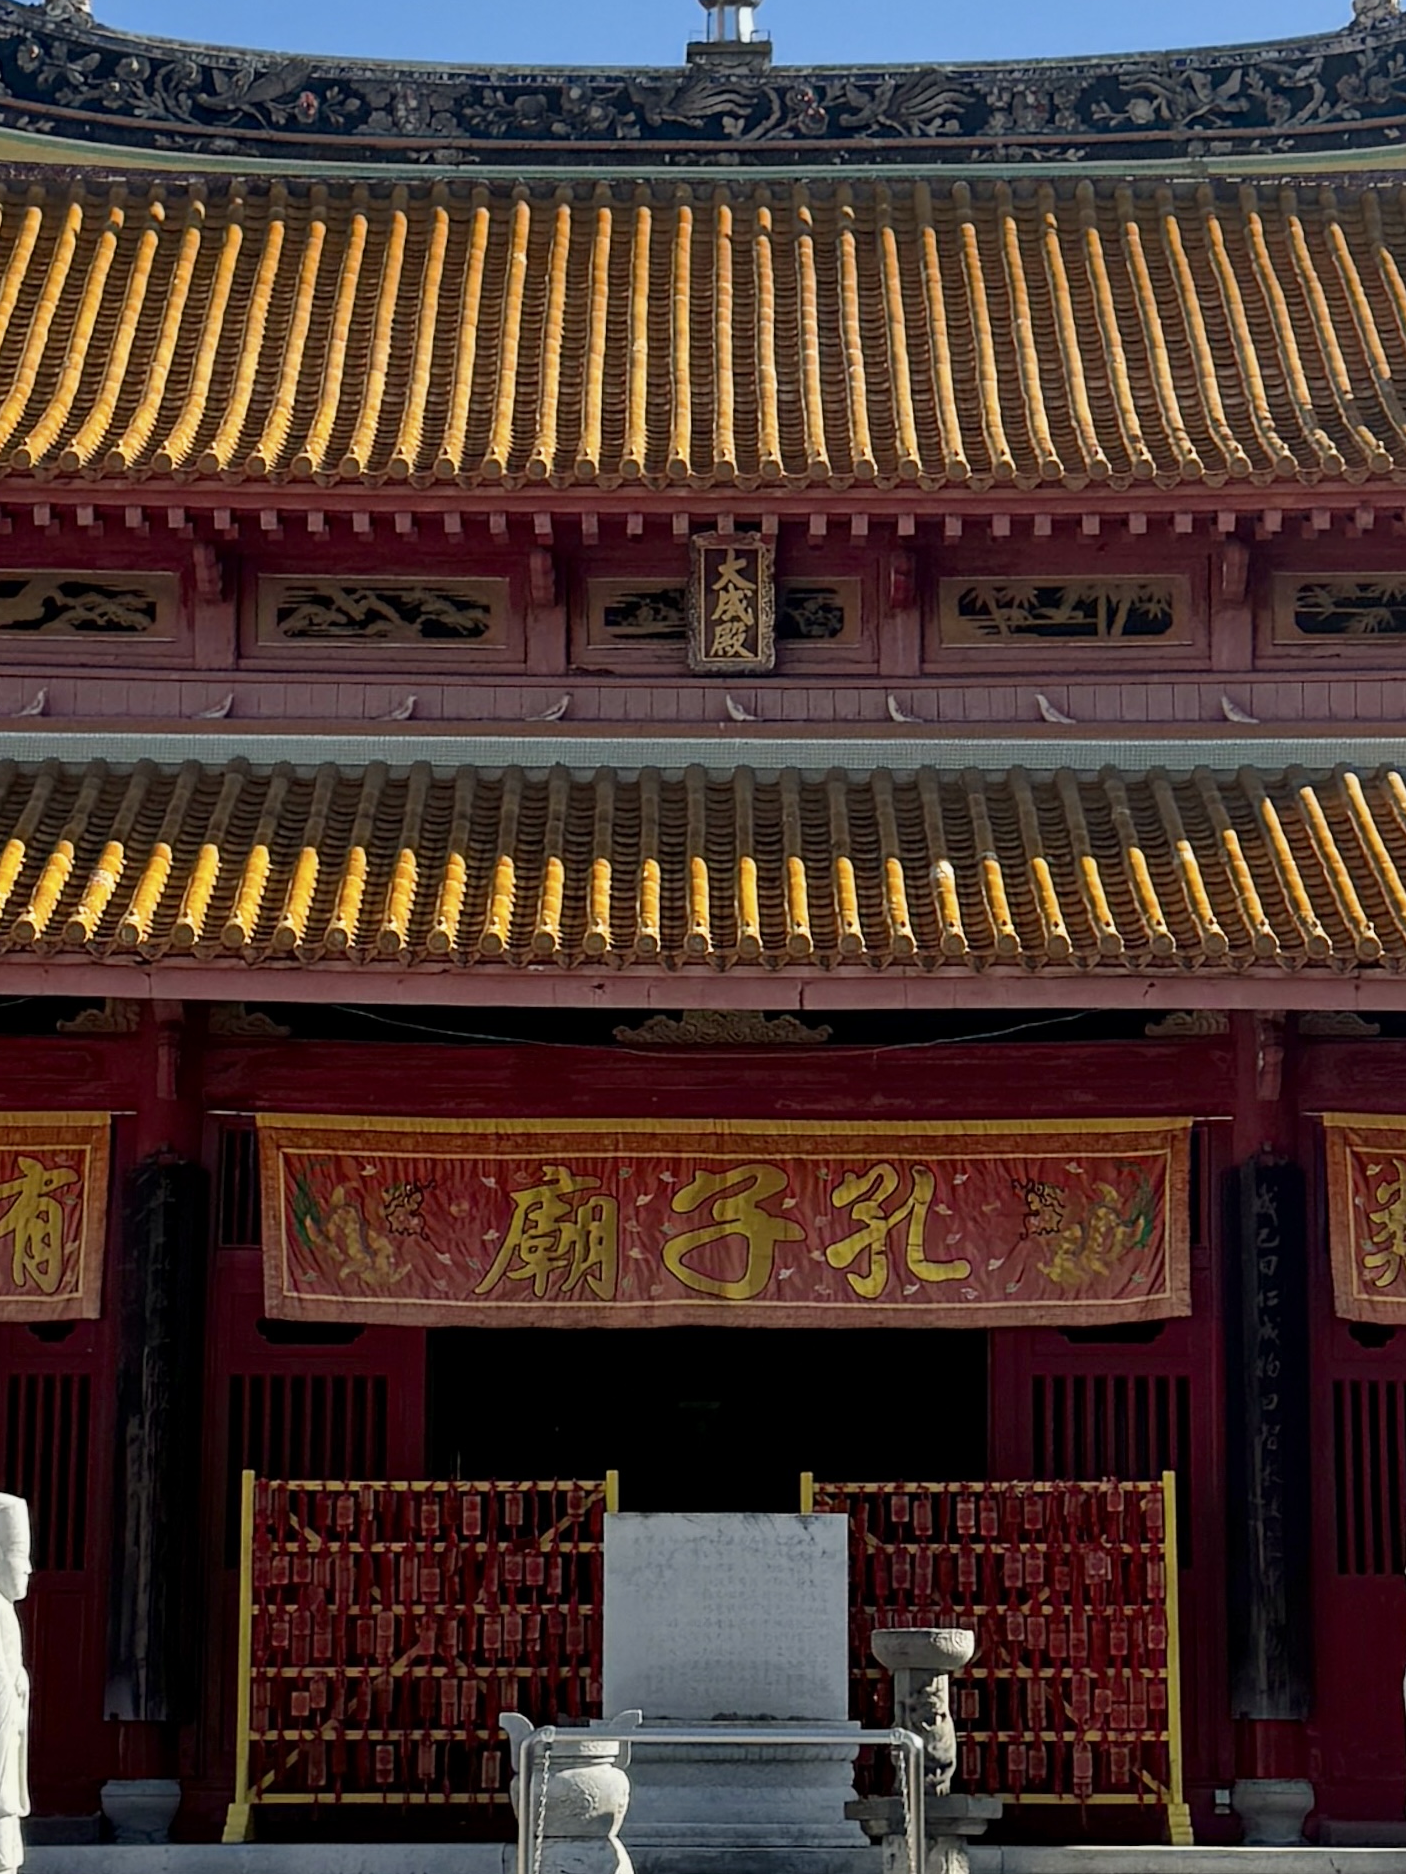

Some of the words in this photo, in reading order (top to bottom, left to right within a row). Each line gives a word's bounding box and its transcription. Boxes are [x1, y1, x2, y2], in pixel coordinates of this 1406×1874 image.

[710, 548, 757, 658] 大成殿
[474, 1162, 972, 1301] 孔子廟
